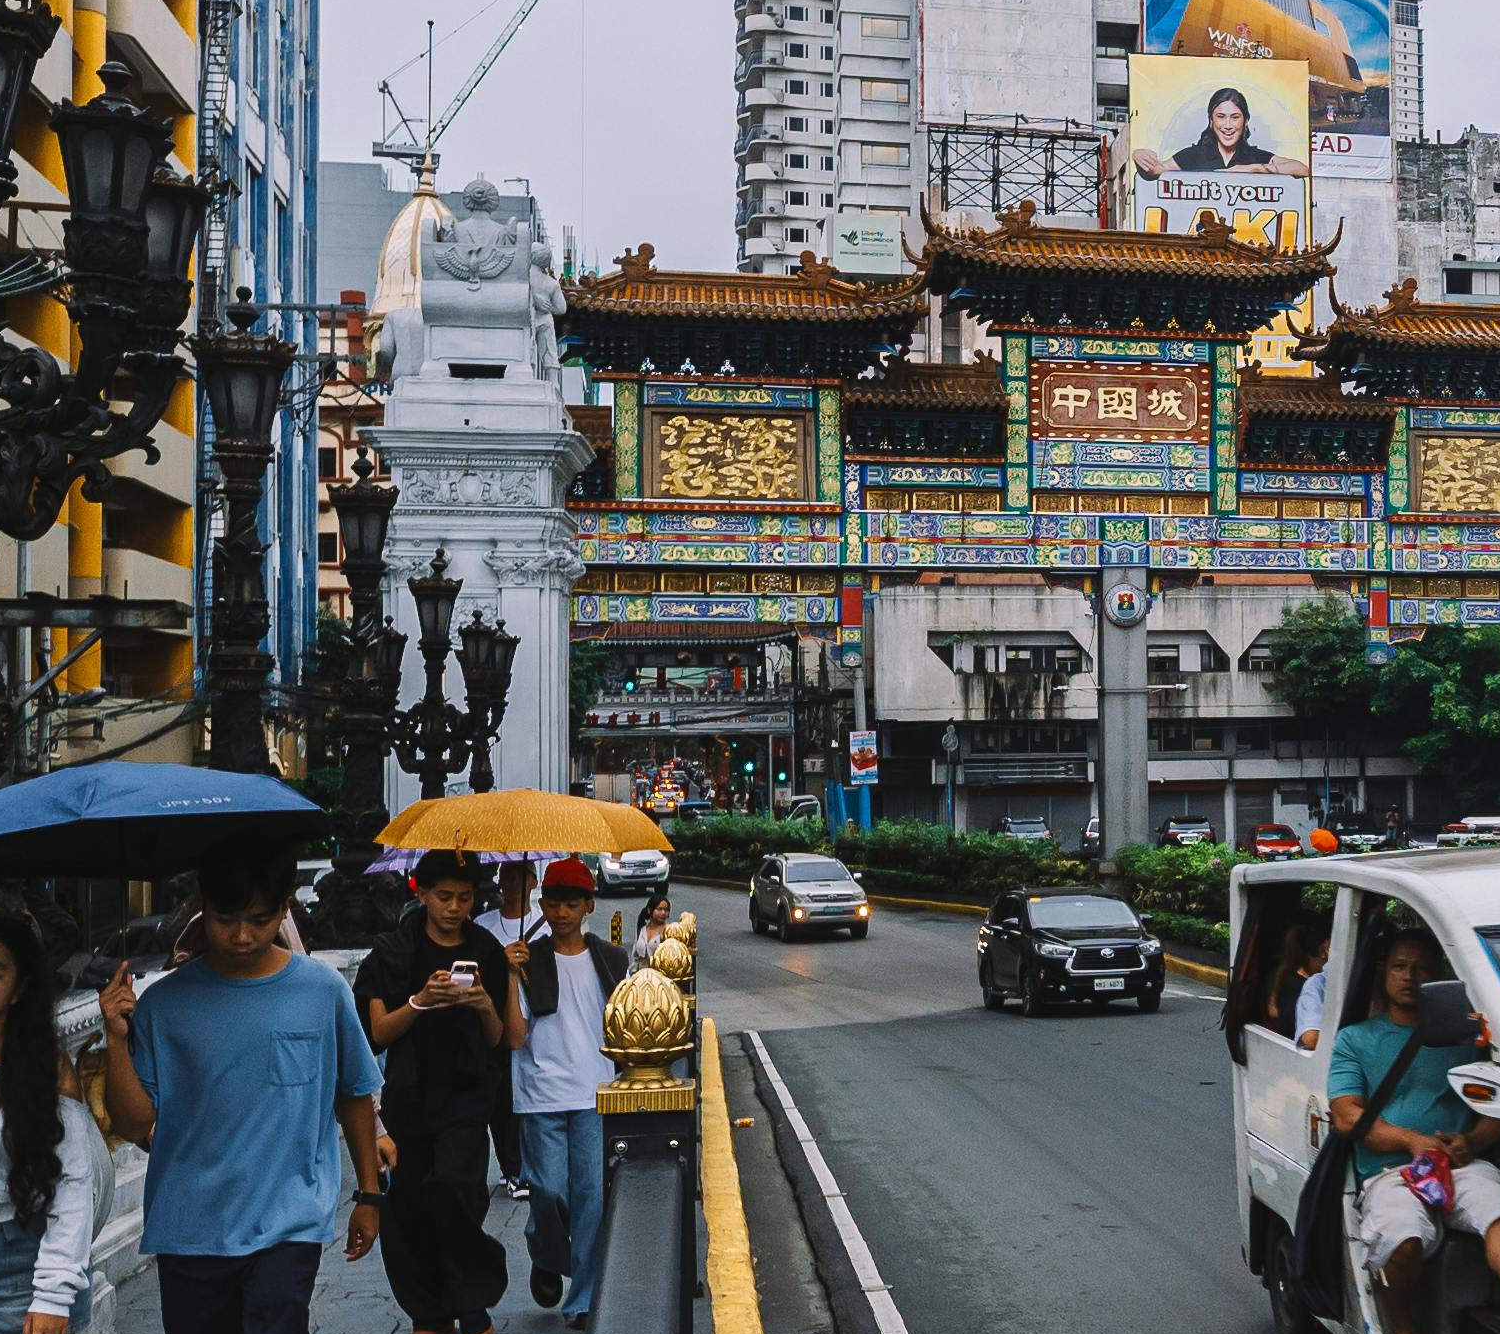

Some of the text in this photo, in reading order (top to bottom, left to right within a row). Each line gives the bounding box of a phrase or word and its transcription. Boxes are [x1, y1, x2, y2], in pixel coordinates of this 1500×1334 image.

[1157, 180, 1284, 206] Limit your
[1052, 385, 1187, 421] 中國城
